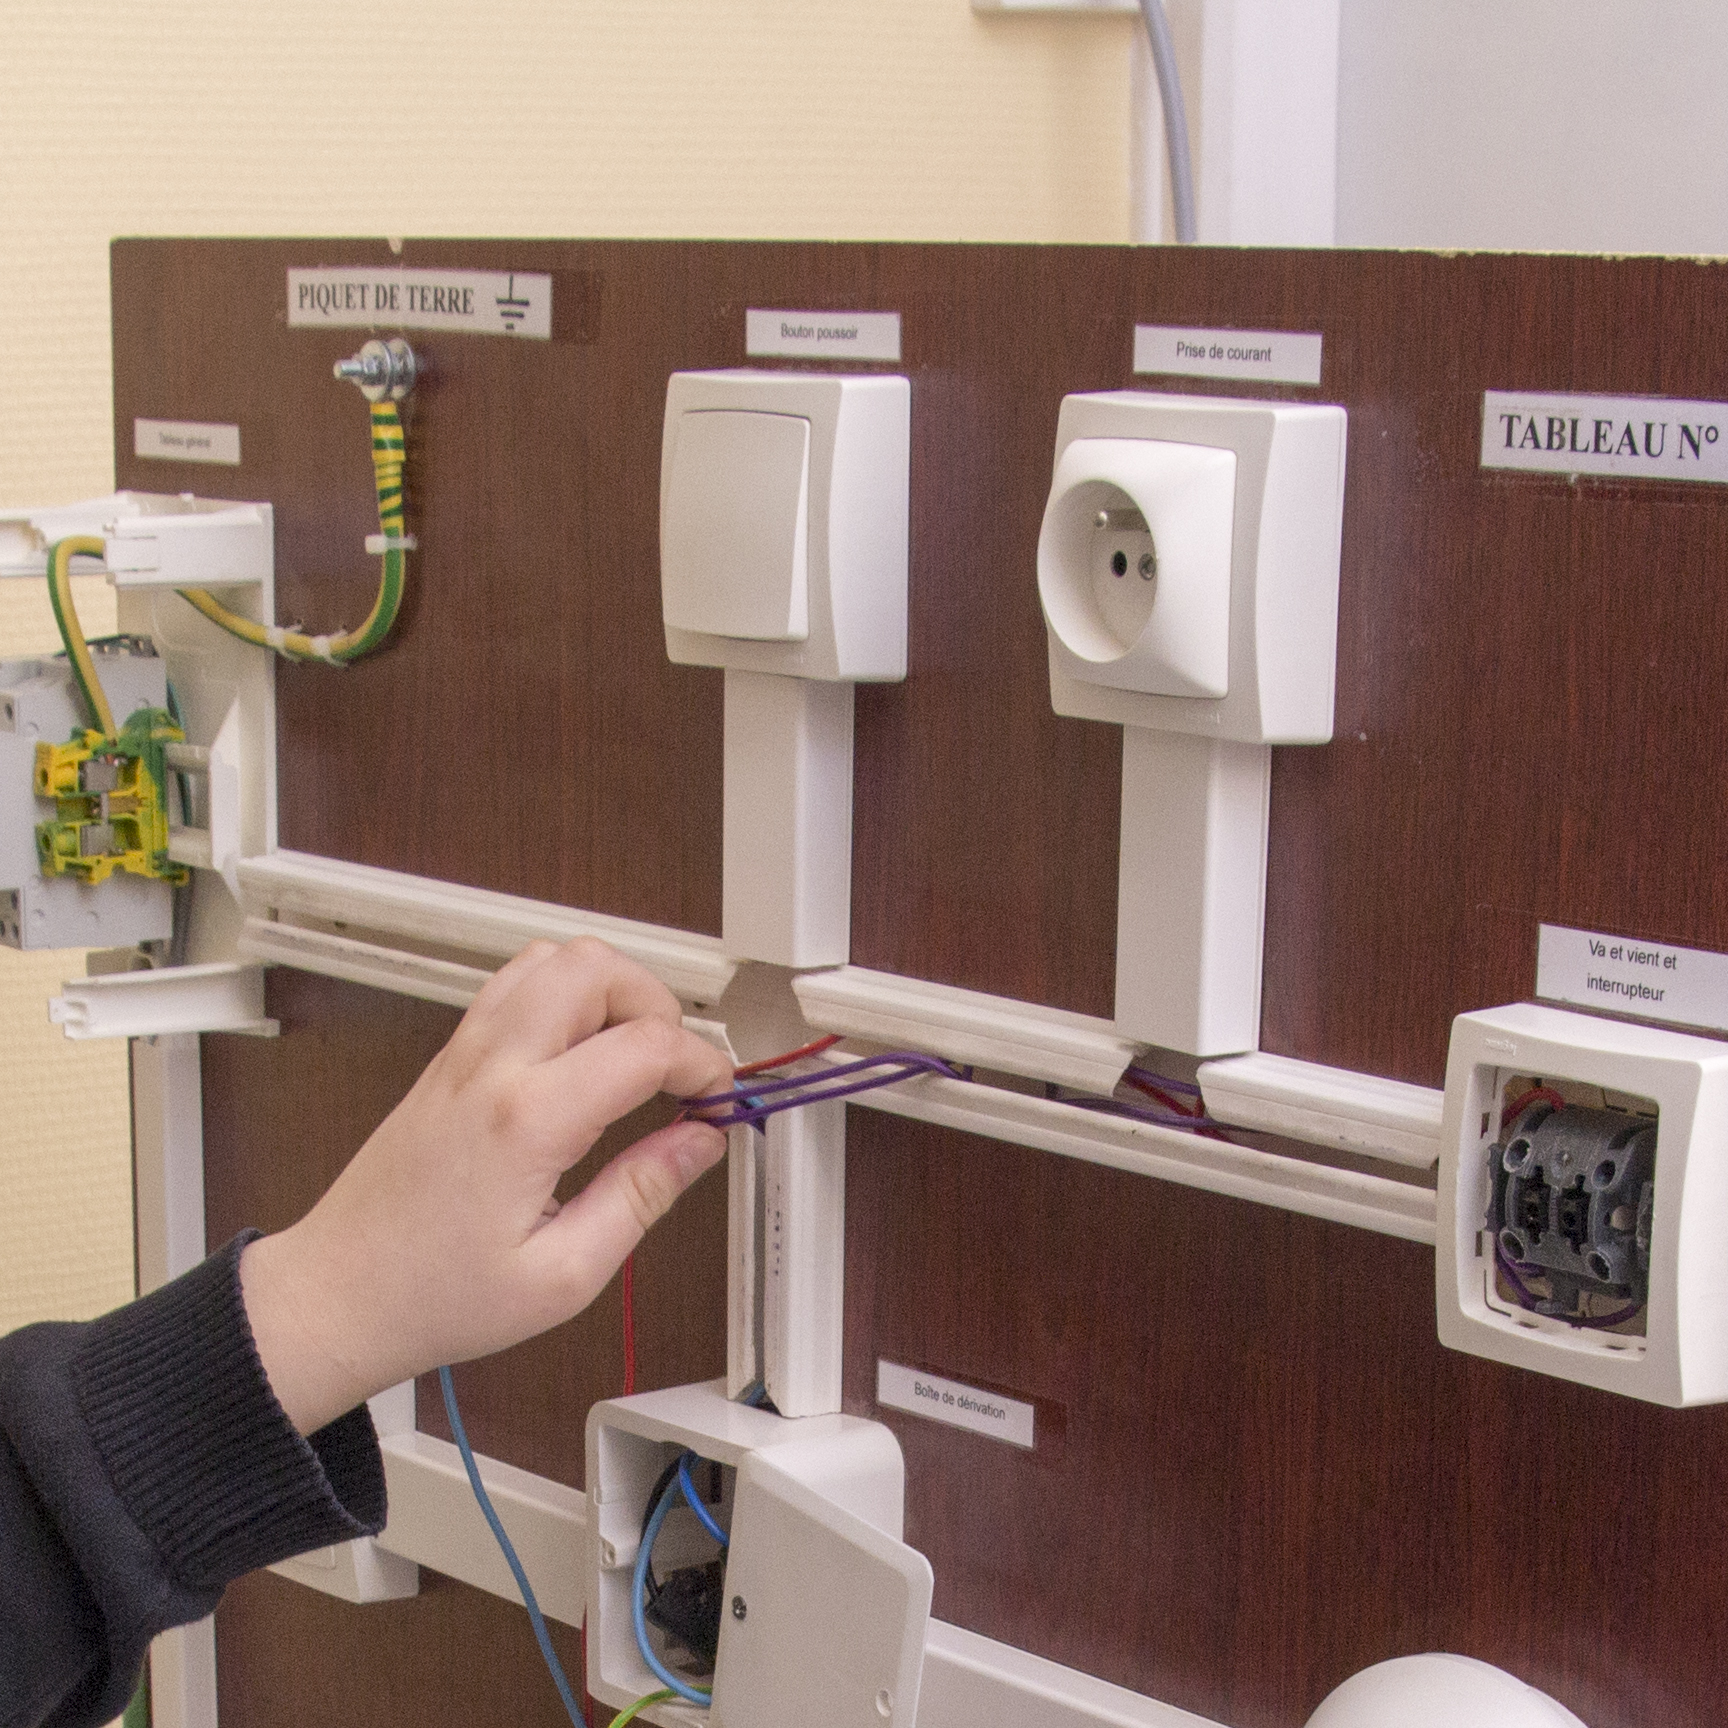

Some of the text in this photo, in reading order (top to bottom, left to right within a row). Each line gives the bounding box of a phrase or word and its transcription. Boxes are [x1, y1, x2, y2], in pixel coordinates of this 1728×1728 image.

[298, 282, 474, 315] PIQUET DE TERRE
[780, 322, 858, 342] Bouton poussoir
[1176, 341, 1271, 362] Prise de courant
[1500, 413, 1667, 458] TABLEAU
[1588, 939, 1677, 970] Va et vient et
[1587, 972, 1665, 1001] interrupteur
[914, 1381, 1006, 1420] Boîte de dérivation
